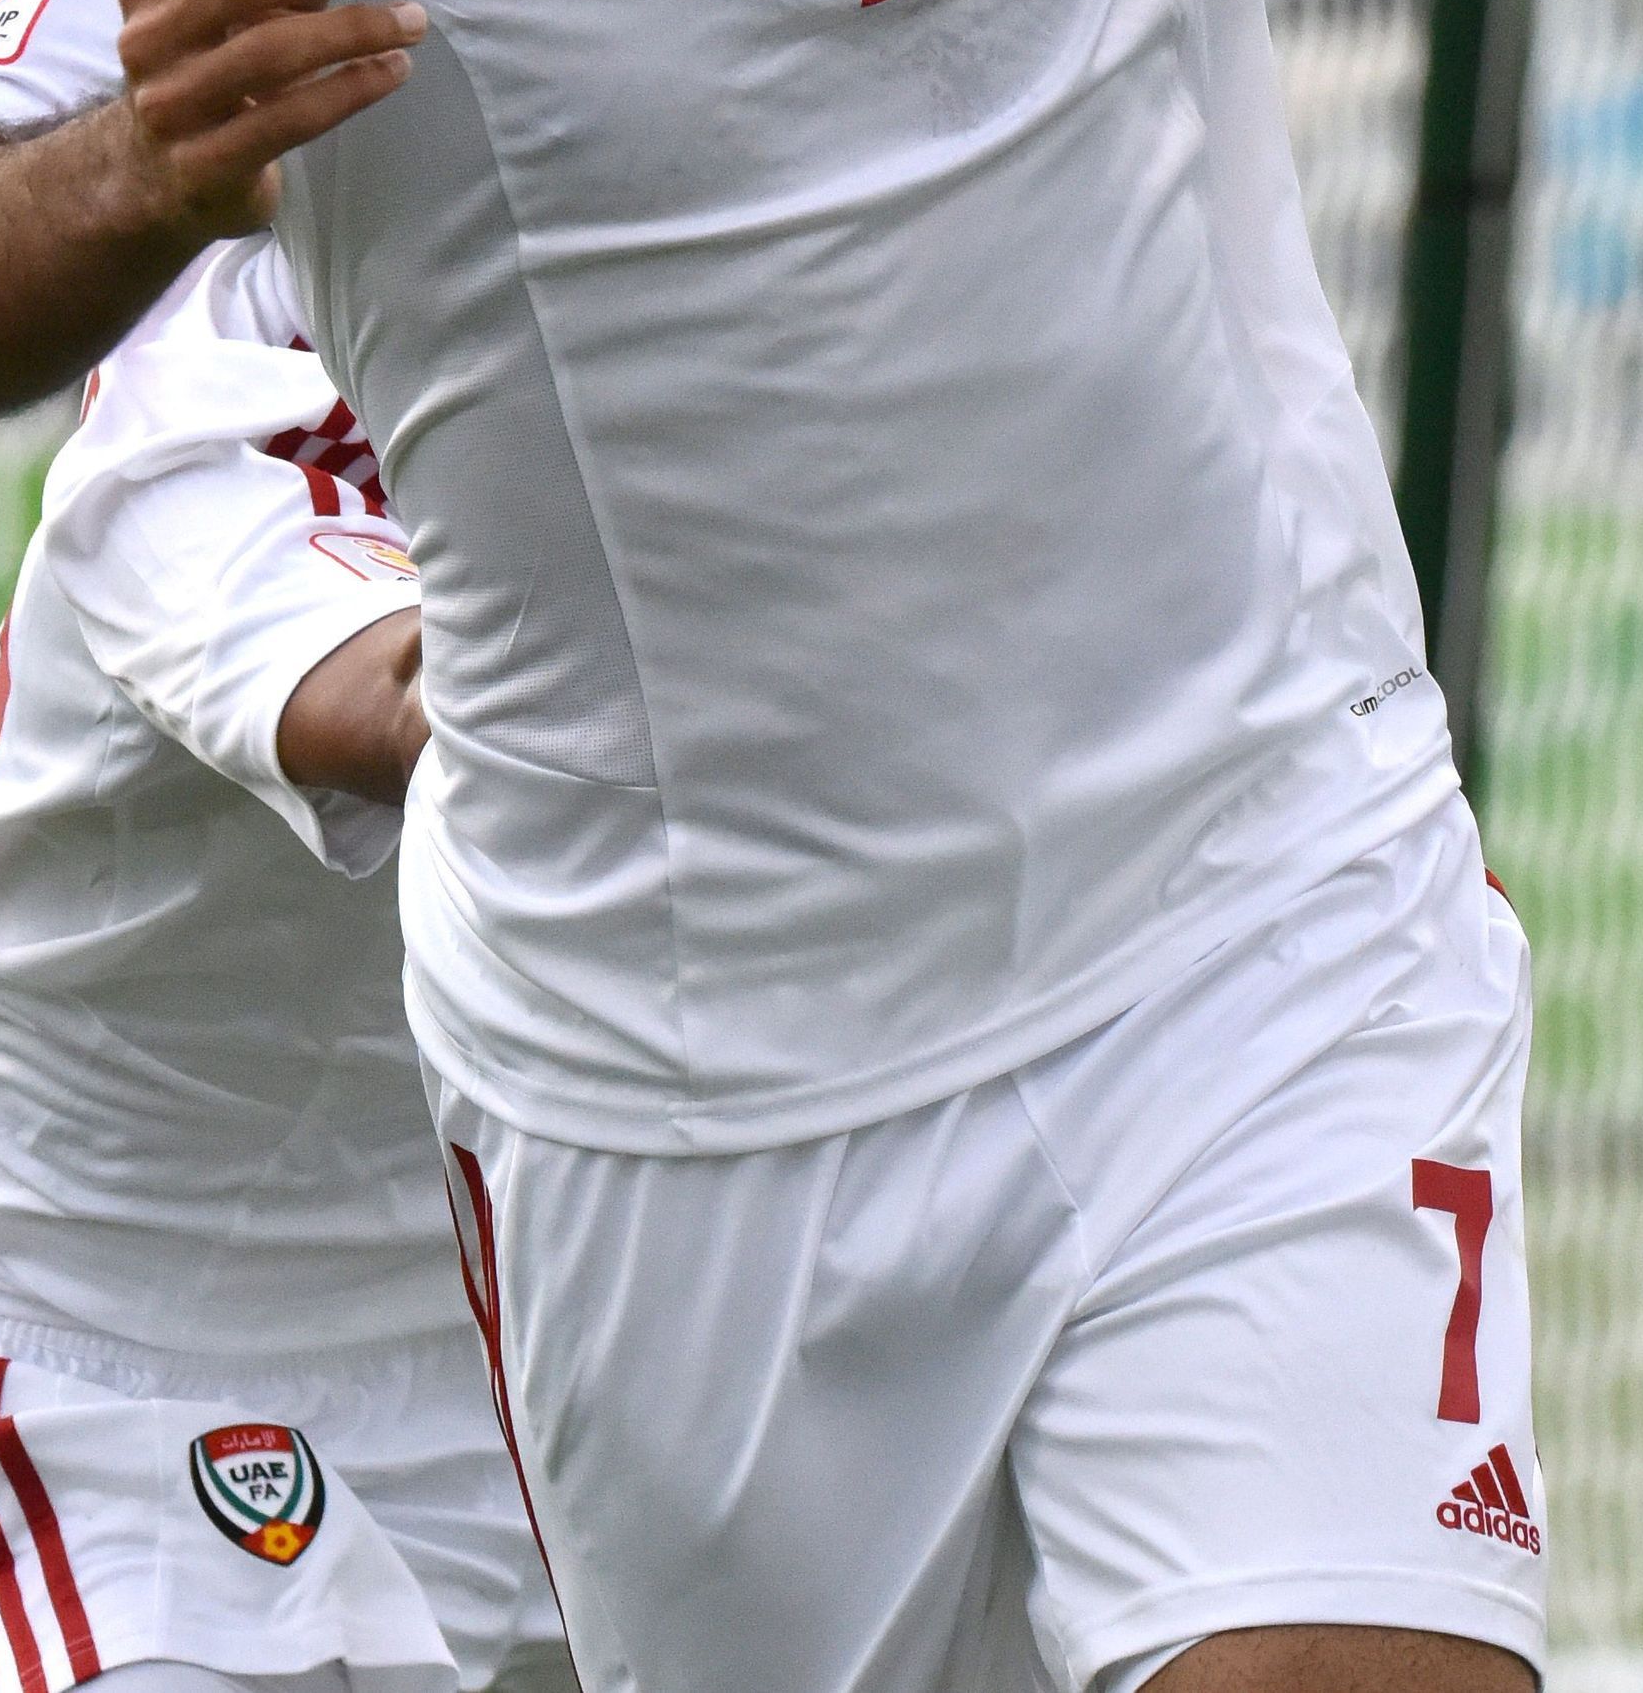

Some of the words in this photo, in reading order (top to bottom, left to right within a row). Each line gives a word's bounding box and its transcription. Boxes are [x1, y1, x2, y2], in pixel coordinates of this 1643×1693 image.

[1411, 1157, 1494, 1425] 7
[228, 1461, 289, 1484] UAE
[248, 1482, 281, 1502] FA
[1436, 1500, 1542, 1557] adidas
